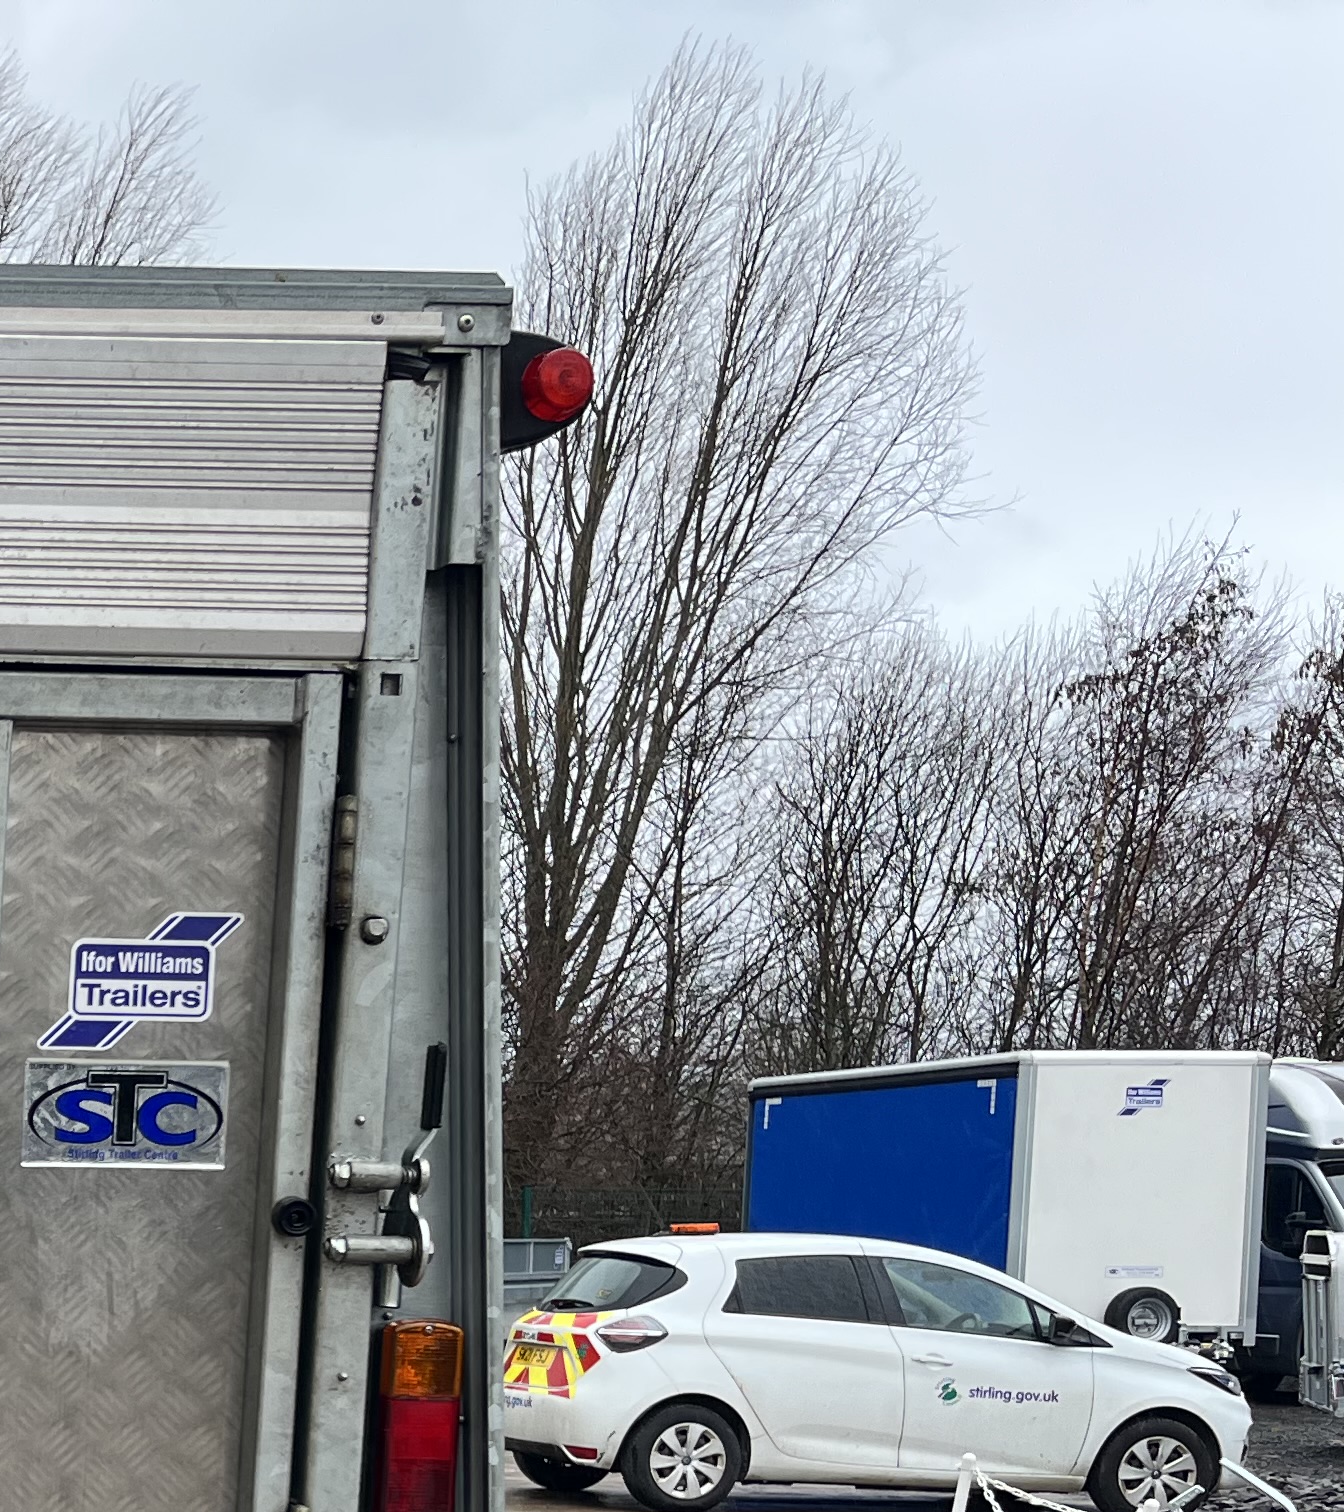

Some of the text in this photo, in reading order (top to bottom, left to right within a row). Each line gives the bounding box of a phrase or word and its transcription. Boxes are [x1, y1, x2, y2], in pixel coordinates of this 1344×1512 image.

[80, 950, 204, 975] Ifor Williams
[54, 1069, 198, 1147] STC
[968, 1385, 1059, 1403] stirling.gov.uk
